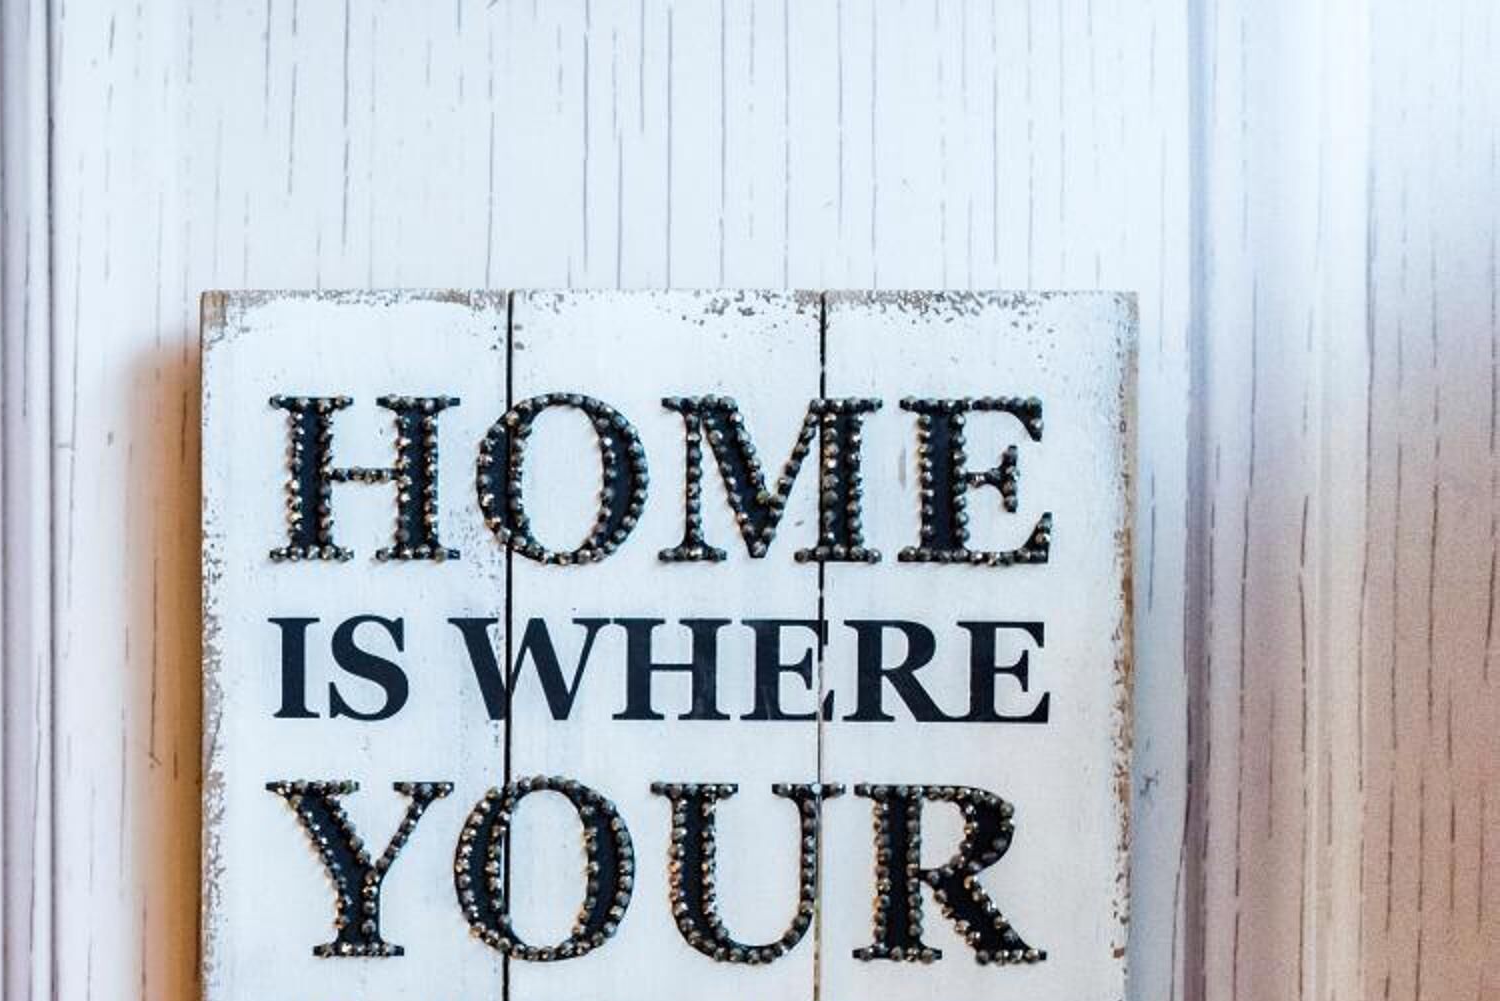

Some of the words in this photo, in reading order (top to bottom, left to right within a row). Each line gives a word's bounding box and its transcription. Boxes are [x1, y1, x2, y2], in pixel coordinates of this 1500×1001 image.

[267, 392, 1053, 567] HOME
[267, 614, 411, 723] IS
[447, 616, 1052, 724] WHERE
[265, 775, 1049, 965] YOUR
